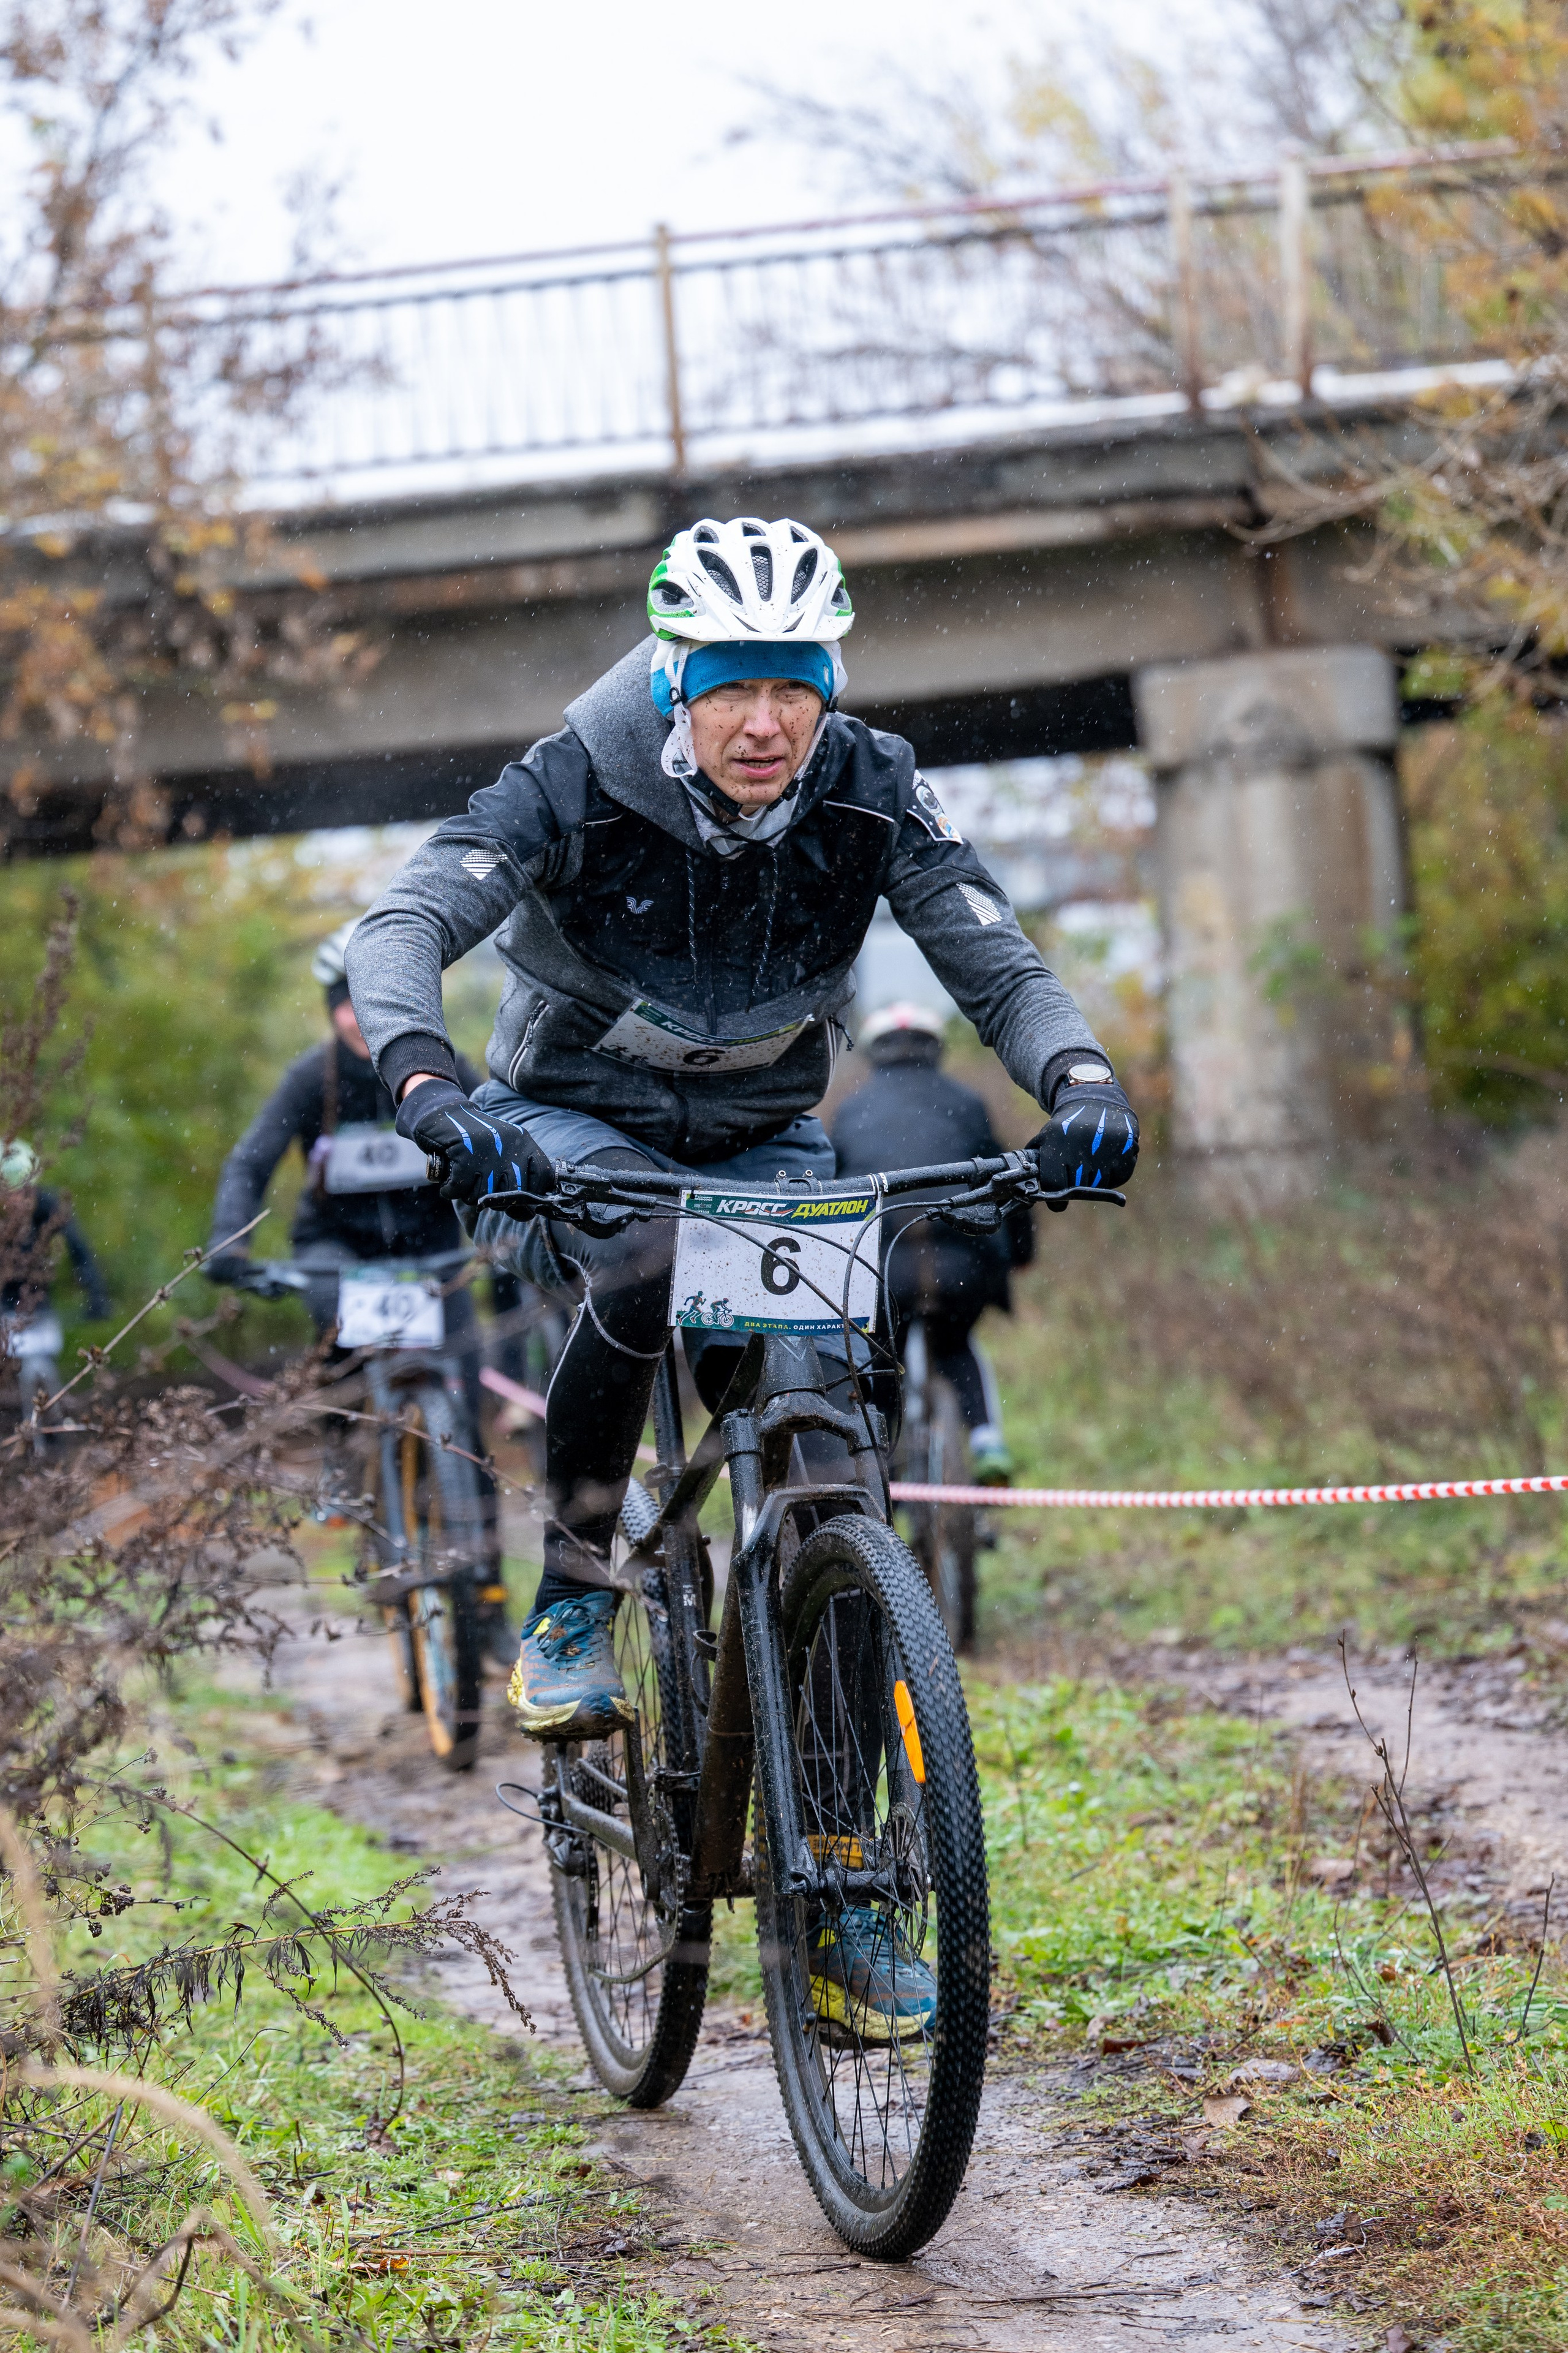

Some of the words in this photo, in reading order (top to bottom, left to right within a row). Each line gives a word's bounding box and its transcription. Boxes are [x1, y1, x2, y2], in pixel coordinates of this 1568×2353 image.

[683, 1049, 726, 1066] 6
[716, 1199, 794, 1217] КРОСС
[791, 1199, 869, 1219] ДУАТЛОН
[760, 1237, 802, 1296] 6
